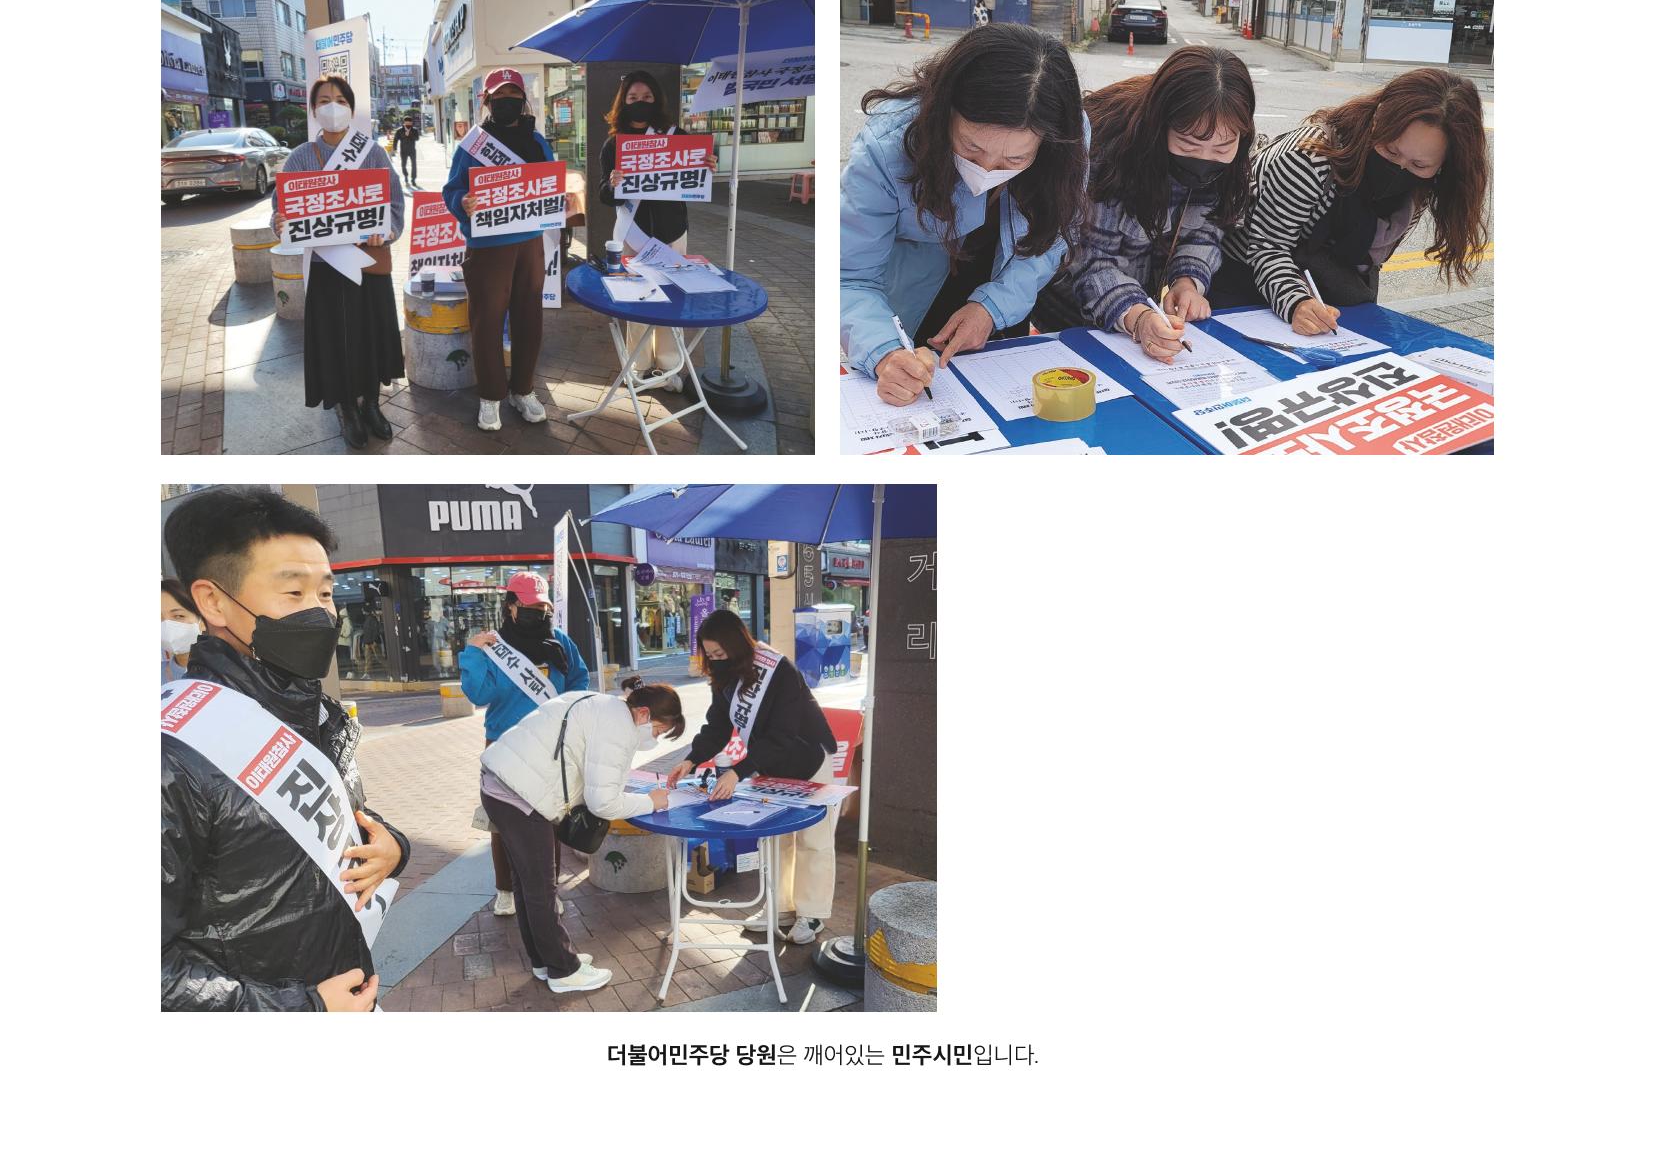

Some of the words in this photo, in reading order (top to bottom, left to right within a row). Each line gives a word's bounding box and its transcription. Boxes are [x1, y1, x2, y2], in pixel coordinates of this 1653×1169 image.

[621, 148, 706, 171] 국정조사로
[475, 175, 557, 207] 국정조사로
[621, 169, 708, 194] 진상규명!
[285, 184, 384, 215] 국정조사로
[475, 195, 565, 228] 책임자처벌!
[289, 206, 385, 243] 진상규명!
[1194, 396, 1252, 416] 더불어민주당
[1215, 361, 1420, 450] 진상규명!
[428, 500, 522, 531] PUMA
[245, 732, 297, 789] 이태원참사
